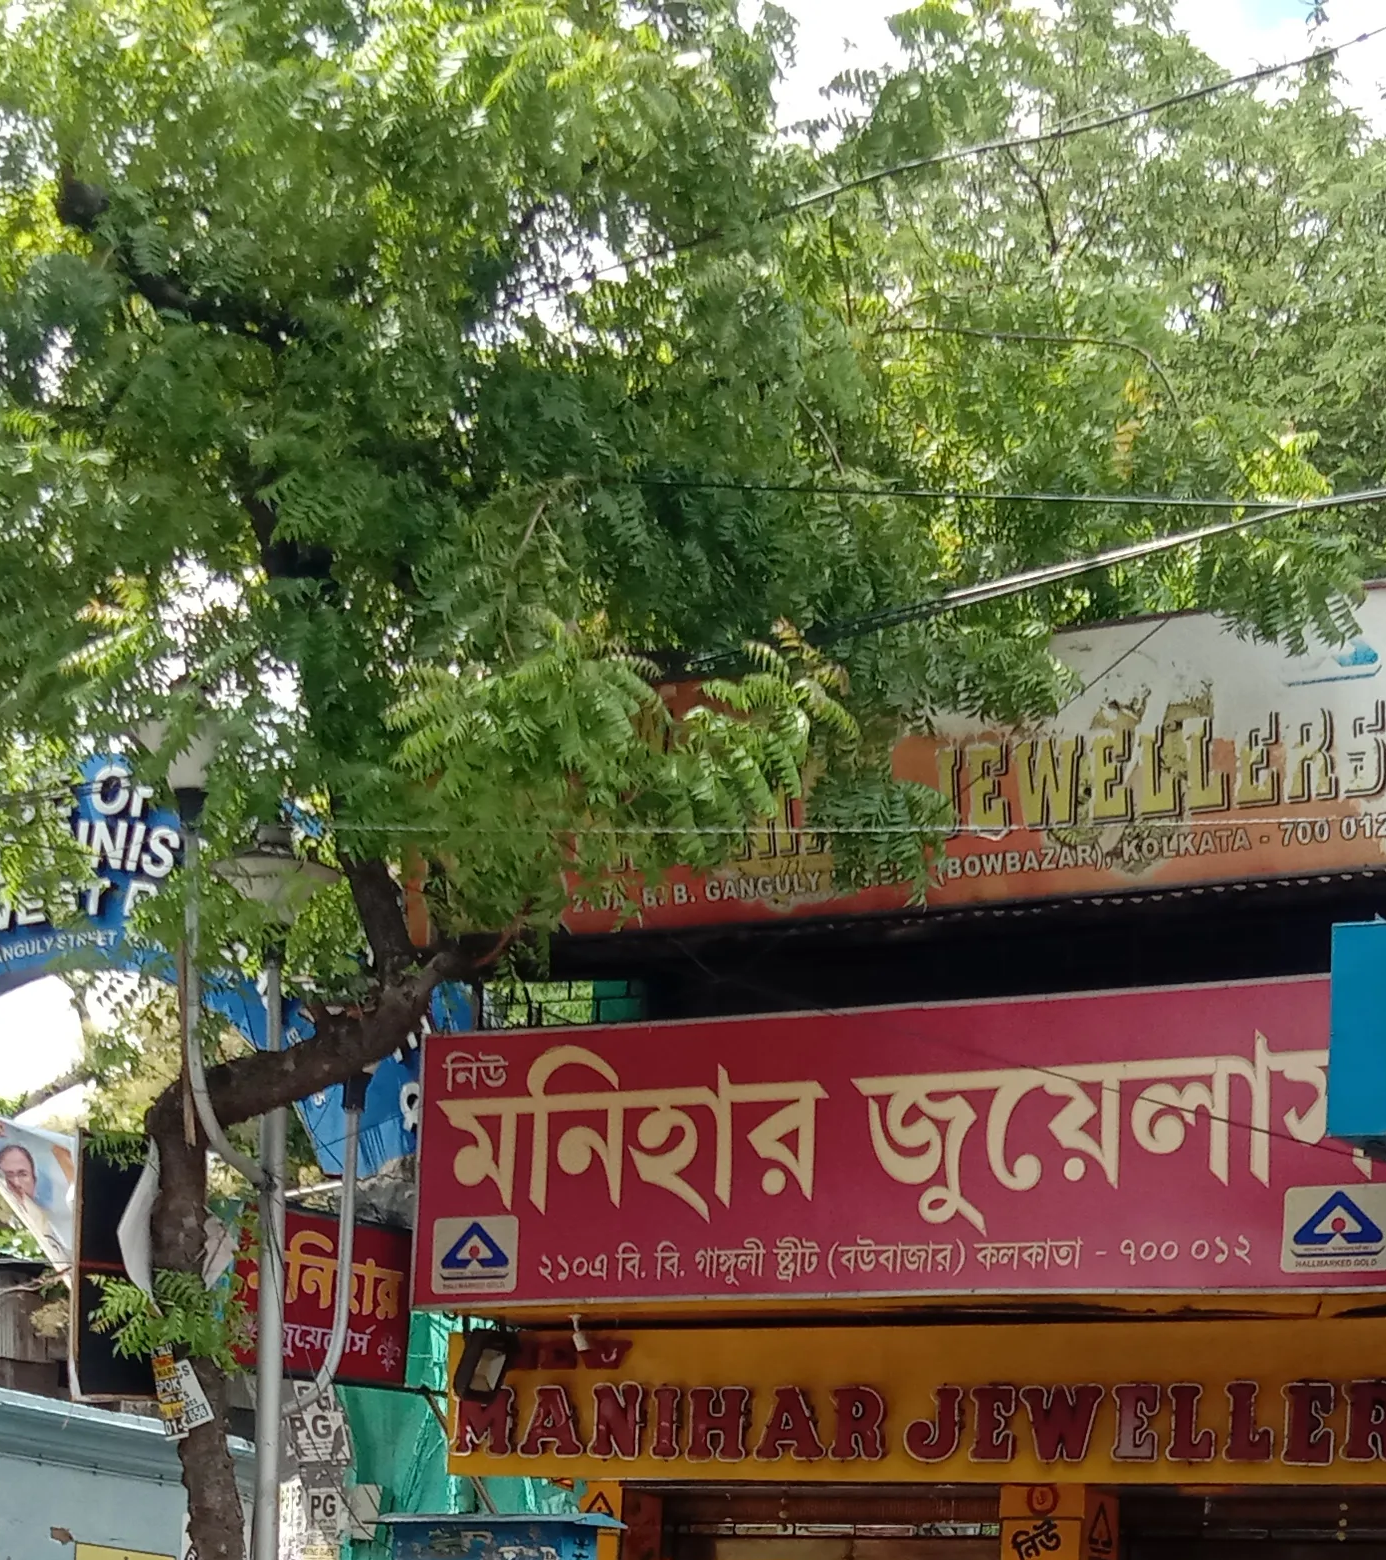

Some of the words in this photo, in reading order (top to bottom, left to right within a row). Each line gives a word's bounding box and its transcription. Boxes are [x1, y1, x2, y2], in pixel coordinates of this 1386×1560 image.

[673, 881, 697, 906] B.
[705, 871, 821, 902] GANGULY
[934, 843, 1112, 887] (BOWBAZAR),
[1121, 827, 1251, 862] KOLKATA
[1280, 821, 1331, 848] 700
[442, 1051, 509, 1092] নিউ
[436, 1044, 830, 1224] মনিহার
[538, 1253, 609, 1283] ২১০এ
[616, 1241, 647, 1281] বি.
[655, 1240, 685, 1281] বি.
[695, 1237, 767, 1287] গাঙ্গুলী
[827, 1237, 967, 1279] (বউবাজার)
[975, 1236, 1084, 1272] কলকাতা
[1119, 1238, 1179, 1267] ৭০০
[1191, 1234, 1253, 1267] ০১২
[449, 1380, 889, 1463] MANIHAR
[311, 1493, 336, 1517] PG
